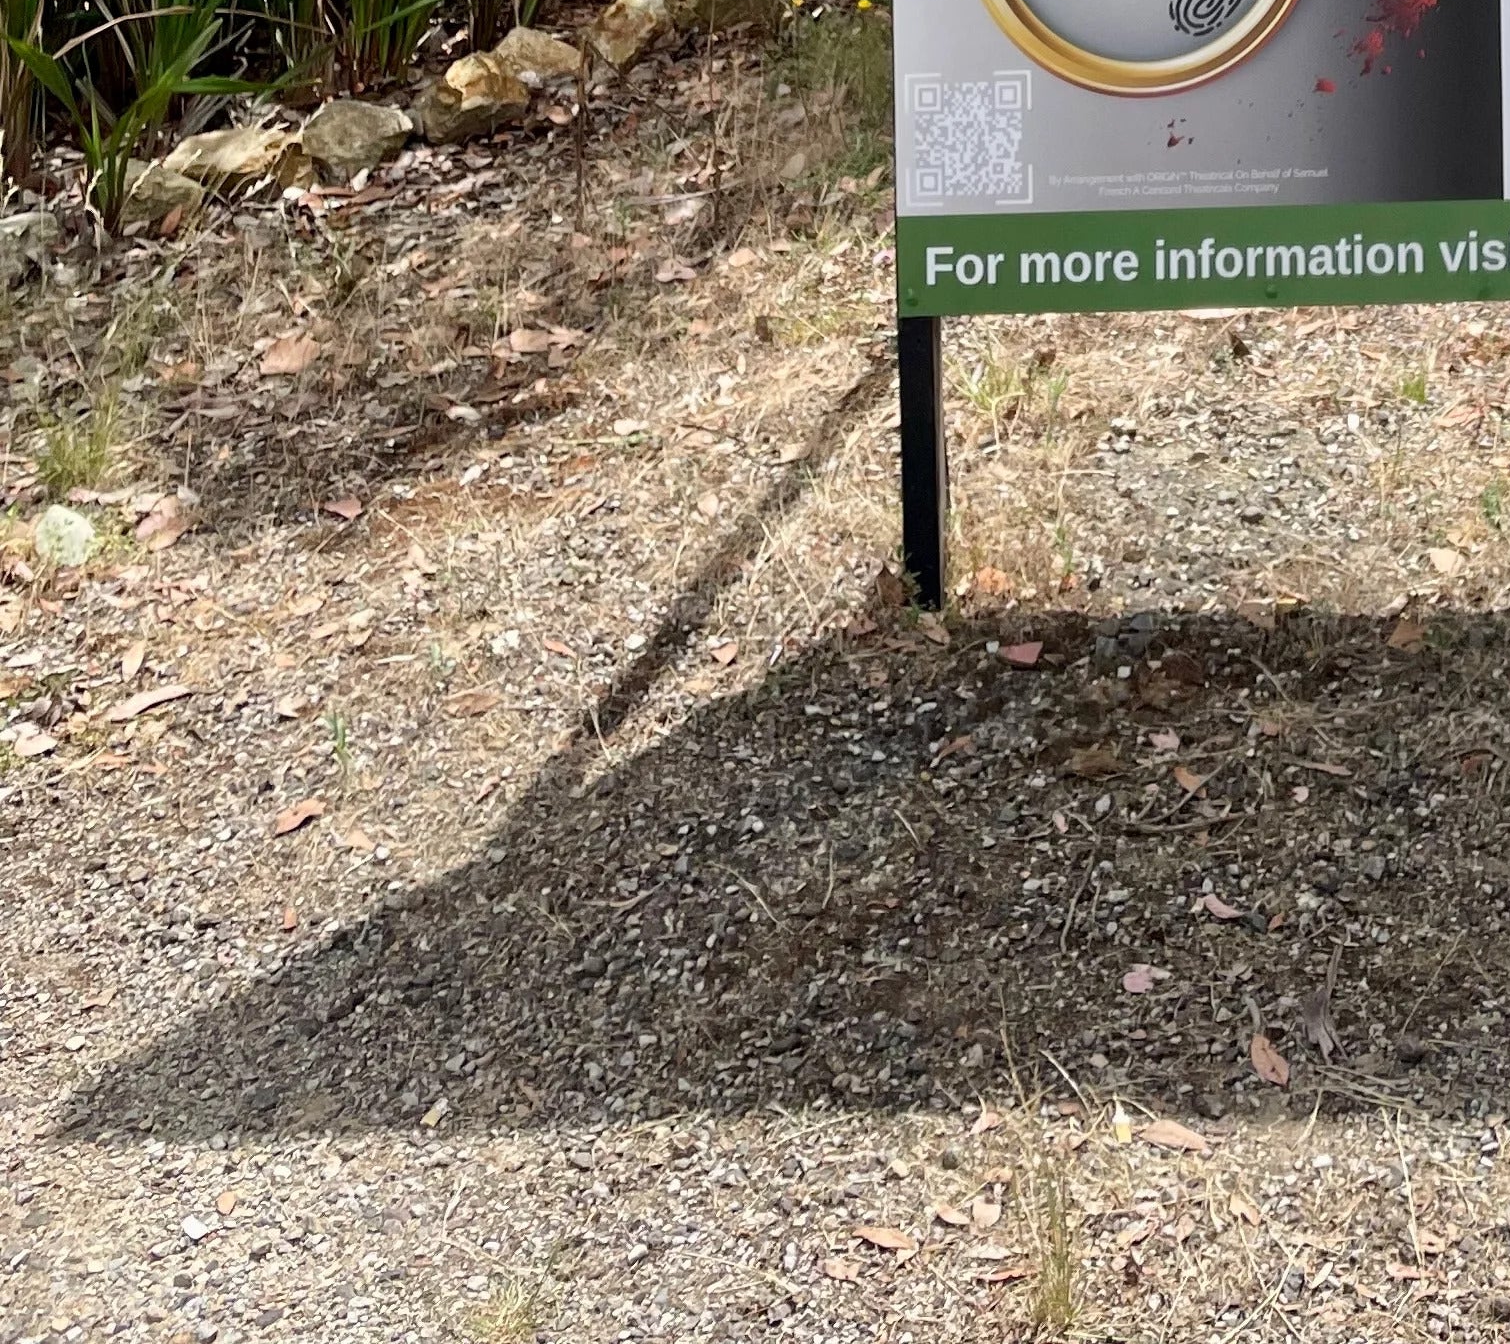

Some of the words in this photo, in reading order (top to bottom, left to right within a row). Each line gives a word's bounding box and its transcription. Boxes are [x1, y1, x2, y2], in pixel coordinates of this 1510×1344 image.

[926, 247, 1004, 285] For
[1020, 250, 1138, 283] more
[1156, 234, 1423, 280] information
